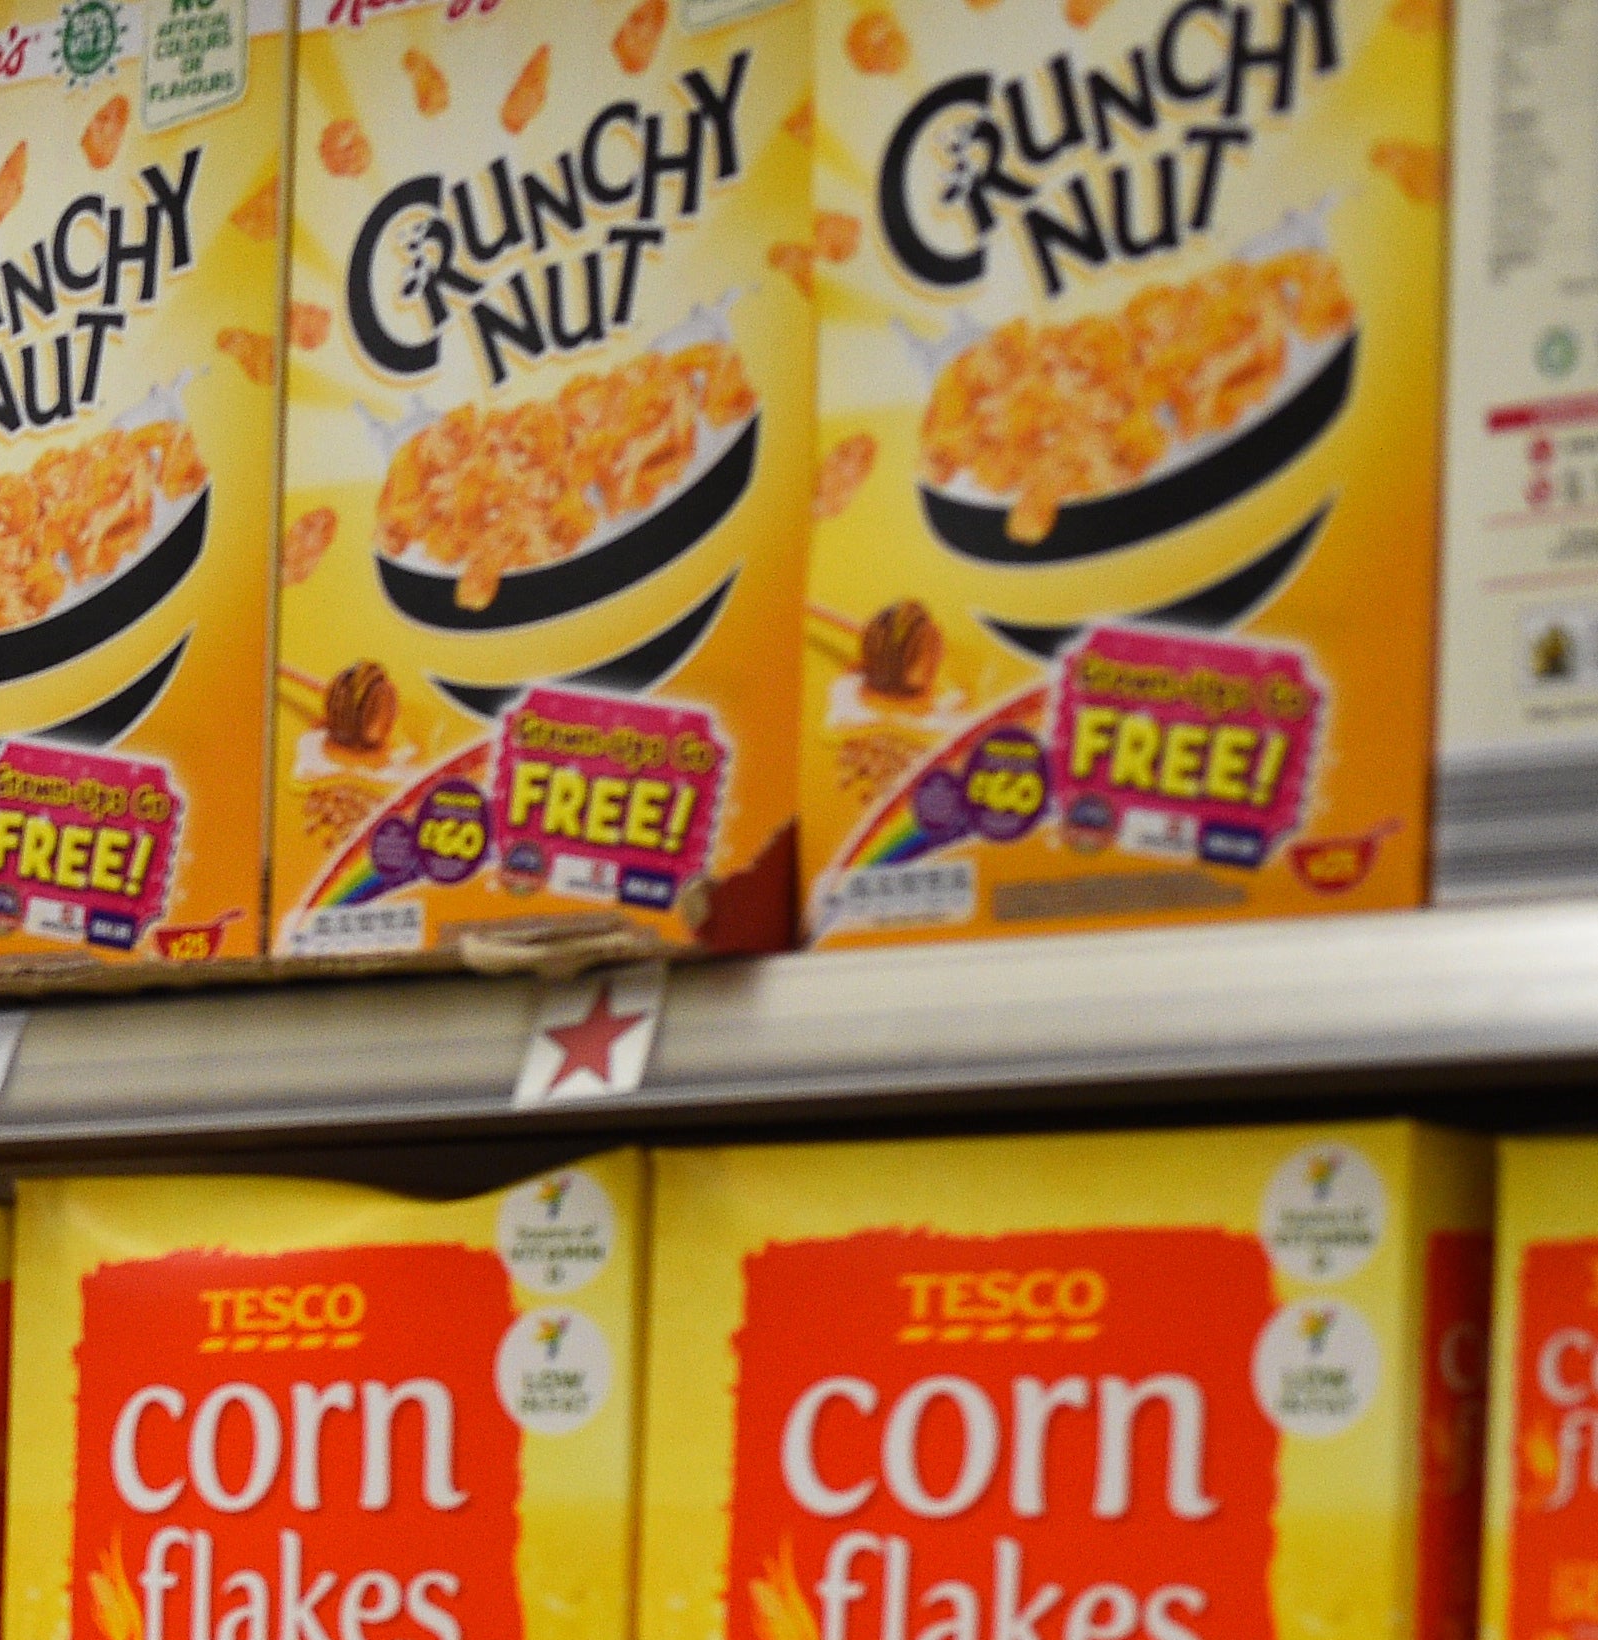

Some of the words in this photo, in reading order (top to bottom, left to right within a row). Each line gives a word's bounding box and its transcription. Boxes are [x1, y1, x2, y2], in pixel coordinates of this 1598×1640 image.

[346, 48, 753, 376] CRUNCHY
[1024, 126, 1251, 297] NUT
[469, 227, 664, 388] NUT
[1068, 710, 1289, 807] FREE!
[110, 1377, 470, 1514] corn
[781, 1373, 1220, 1520] corn
